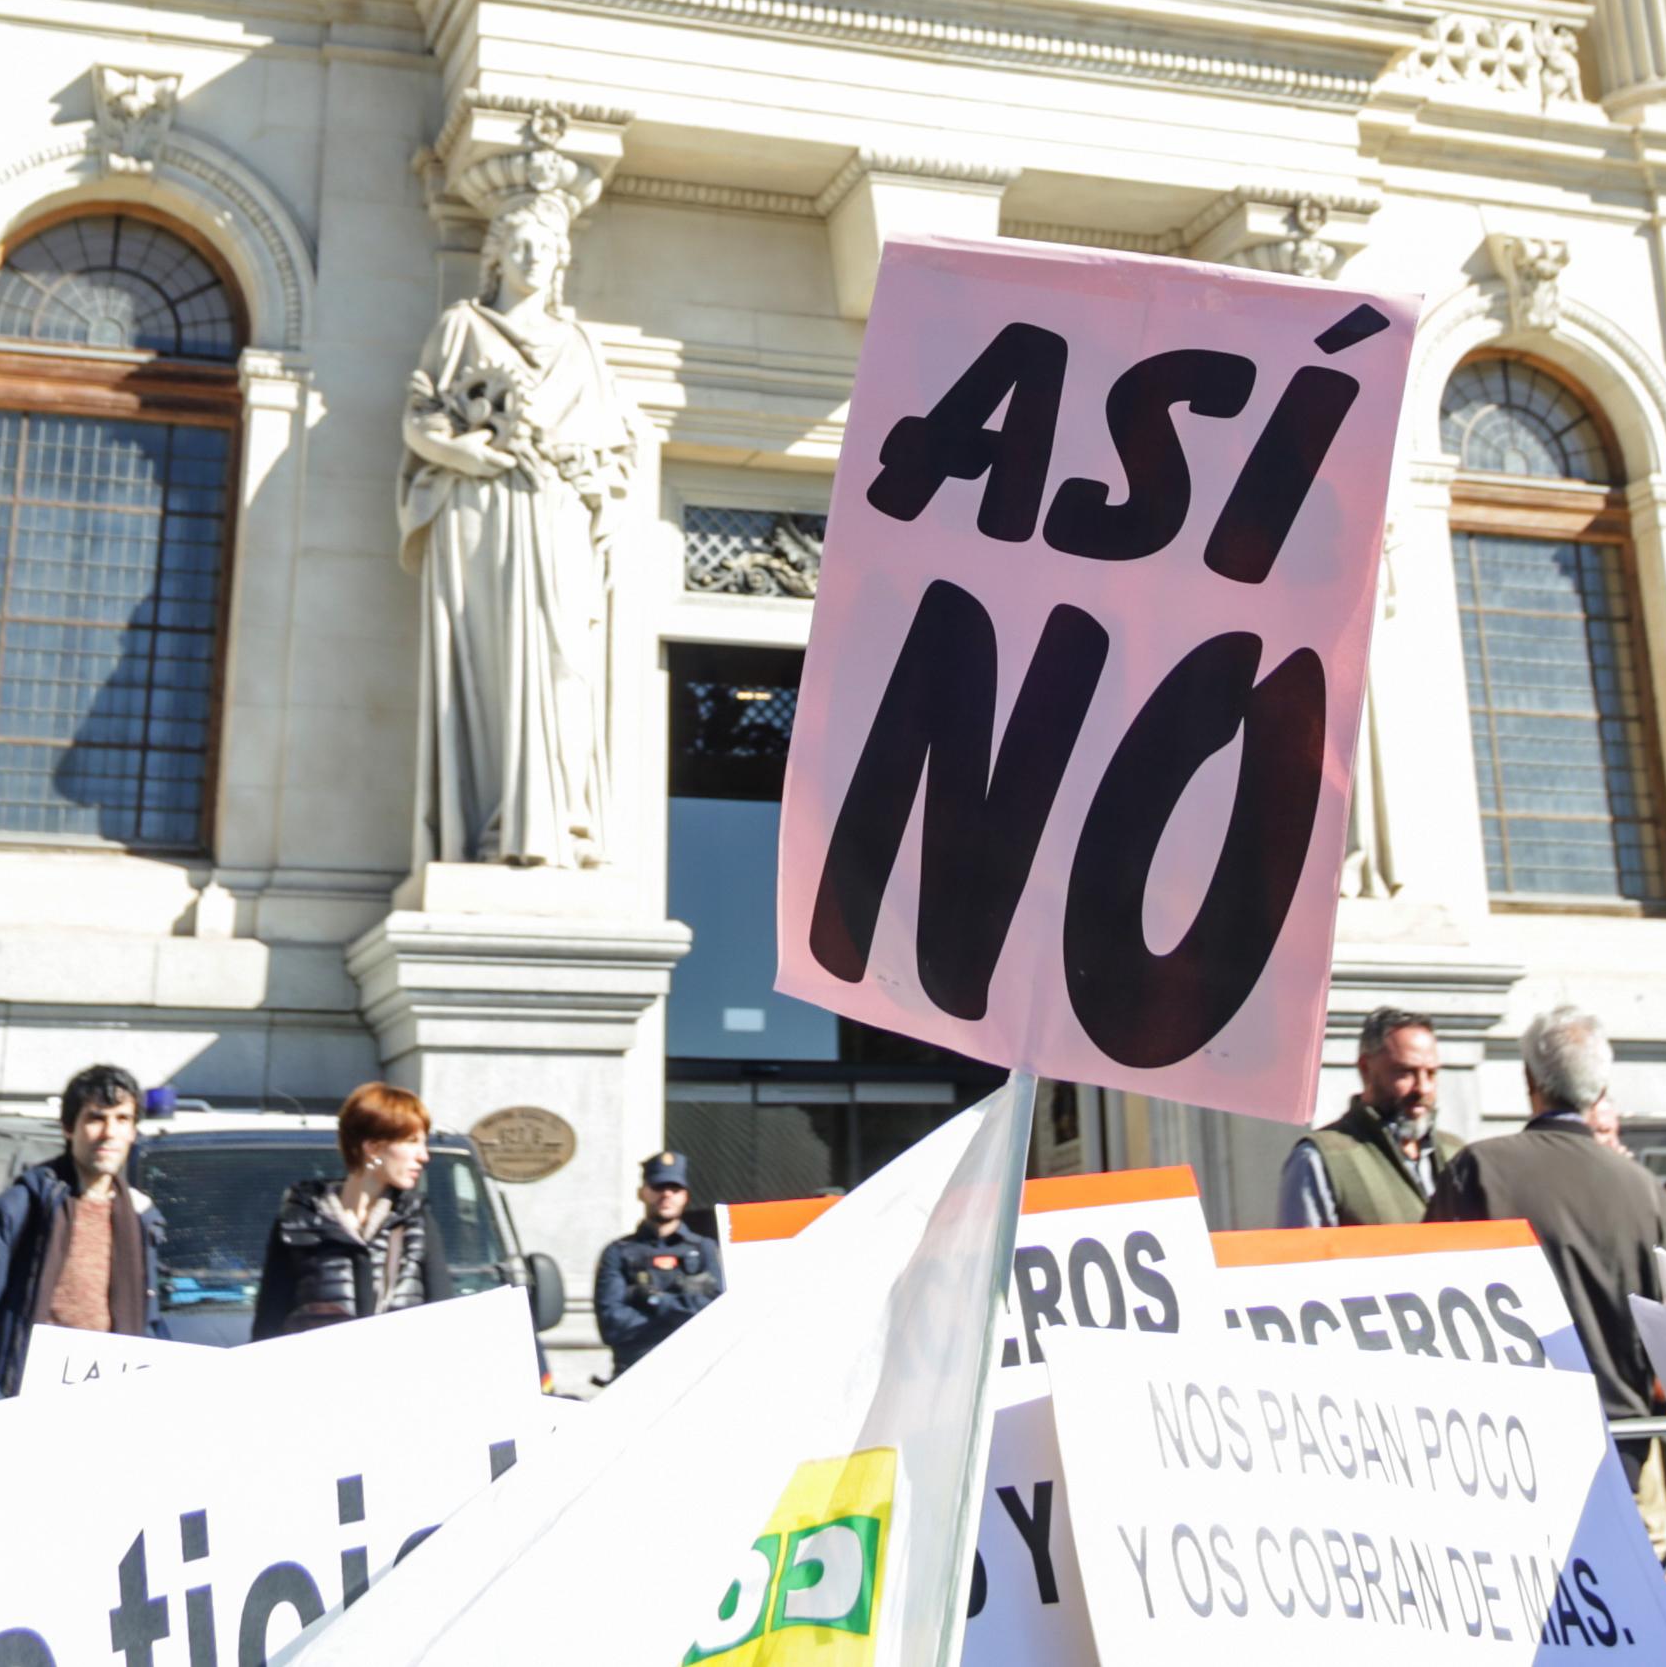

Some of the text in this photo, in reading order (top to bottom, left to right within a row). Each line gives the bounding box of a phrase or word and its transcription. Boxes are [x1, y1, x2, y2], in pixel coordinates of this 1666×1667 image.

[866, 303, 1390, 584] ASÍ
[809, 578, 1327, 1070] NO
[1148, 1380, 1537, 1503] NOS PAGAN POCO
[995, 1480, 1060, 1605] Y
[1117, 1523, 1636, 1648] Y OS COBRAN DE MÁS.
